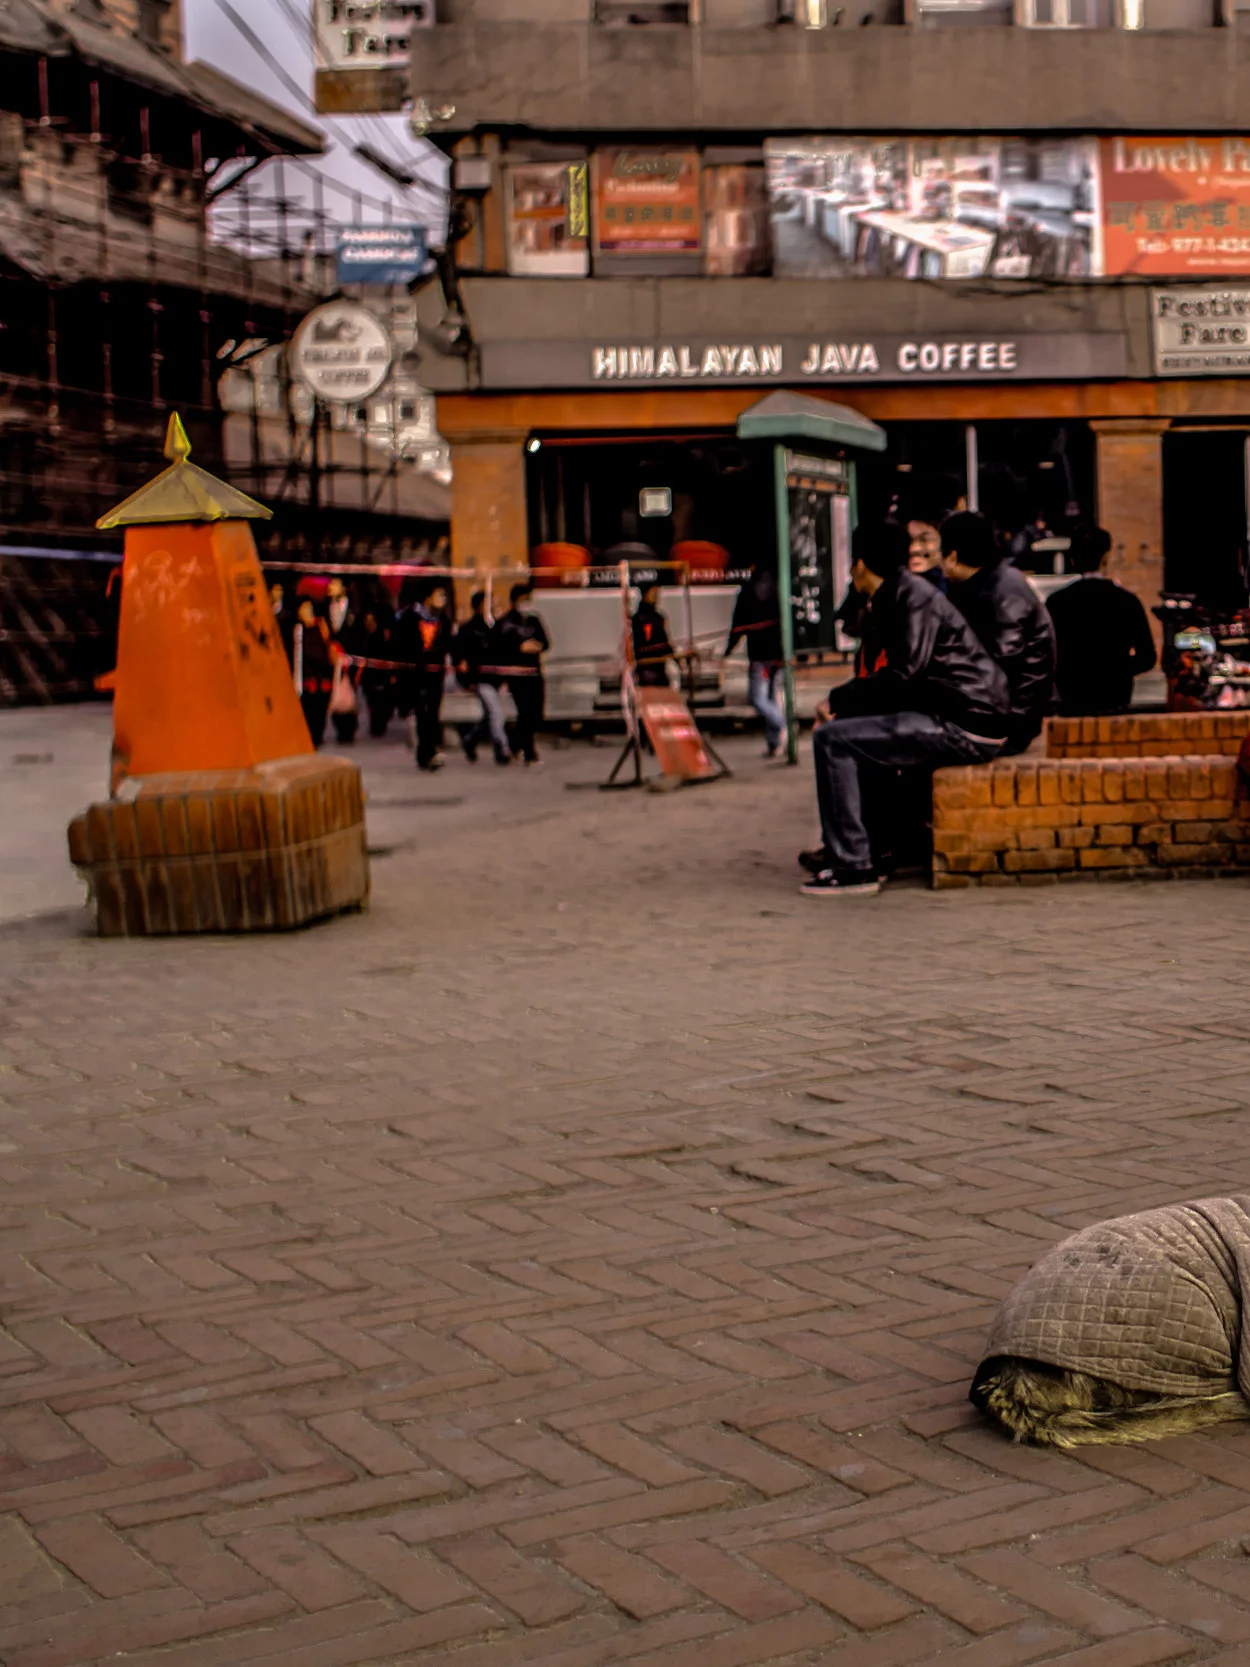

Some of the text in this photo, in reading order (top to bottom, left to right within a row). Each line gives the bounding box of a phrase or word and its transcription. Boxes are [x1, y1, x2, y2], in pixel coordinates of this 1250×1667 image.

[1112, 137, 1211, 173] Lovely
[1179, 322, 1248, 345] Fare
[592, 341, 1017, 379] HIMALAYAN JAVA COFFEE
